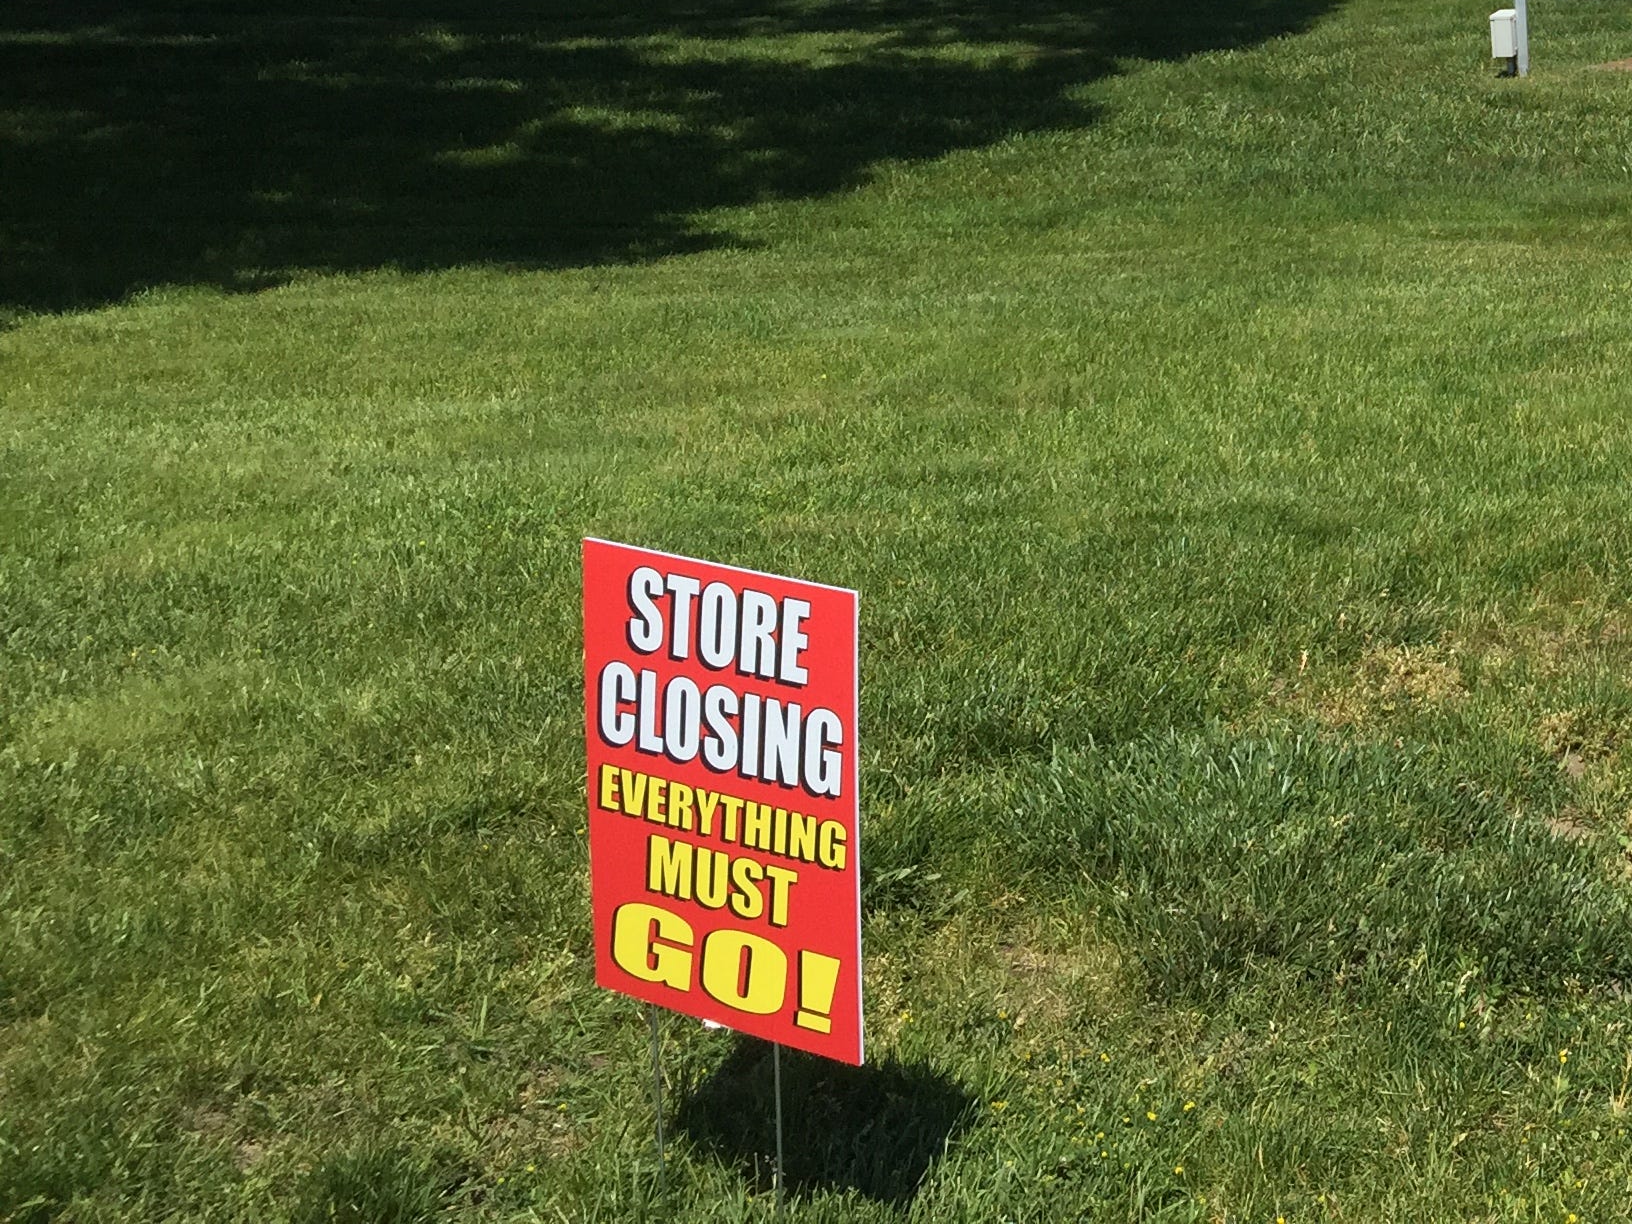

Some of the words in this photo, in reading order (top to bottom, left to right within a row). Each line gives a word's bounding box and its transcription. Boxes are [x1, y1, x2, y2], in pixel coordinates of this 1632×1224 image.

[626, 565, 811, 687] STORE
[598, 660, 844, 797] CLOSING
[598, 763, 848, 871] EVERYTHING
[646, 834, 798, 928] MUST
[612, 901, 842, 1035] GO!
